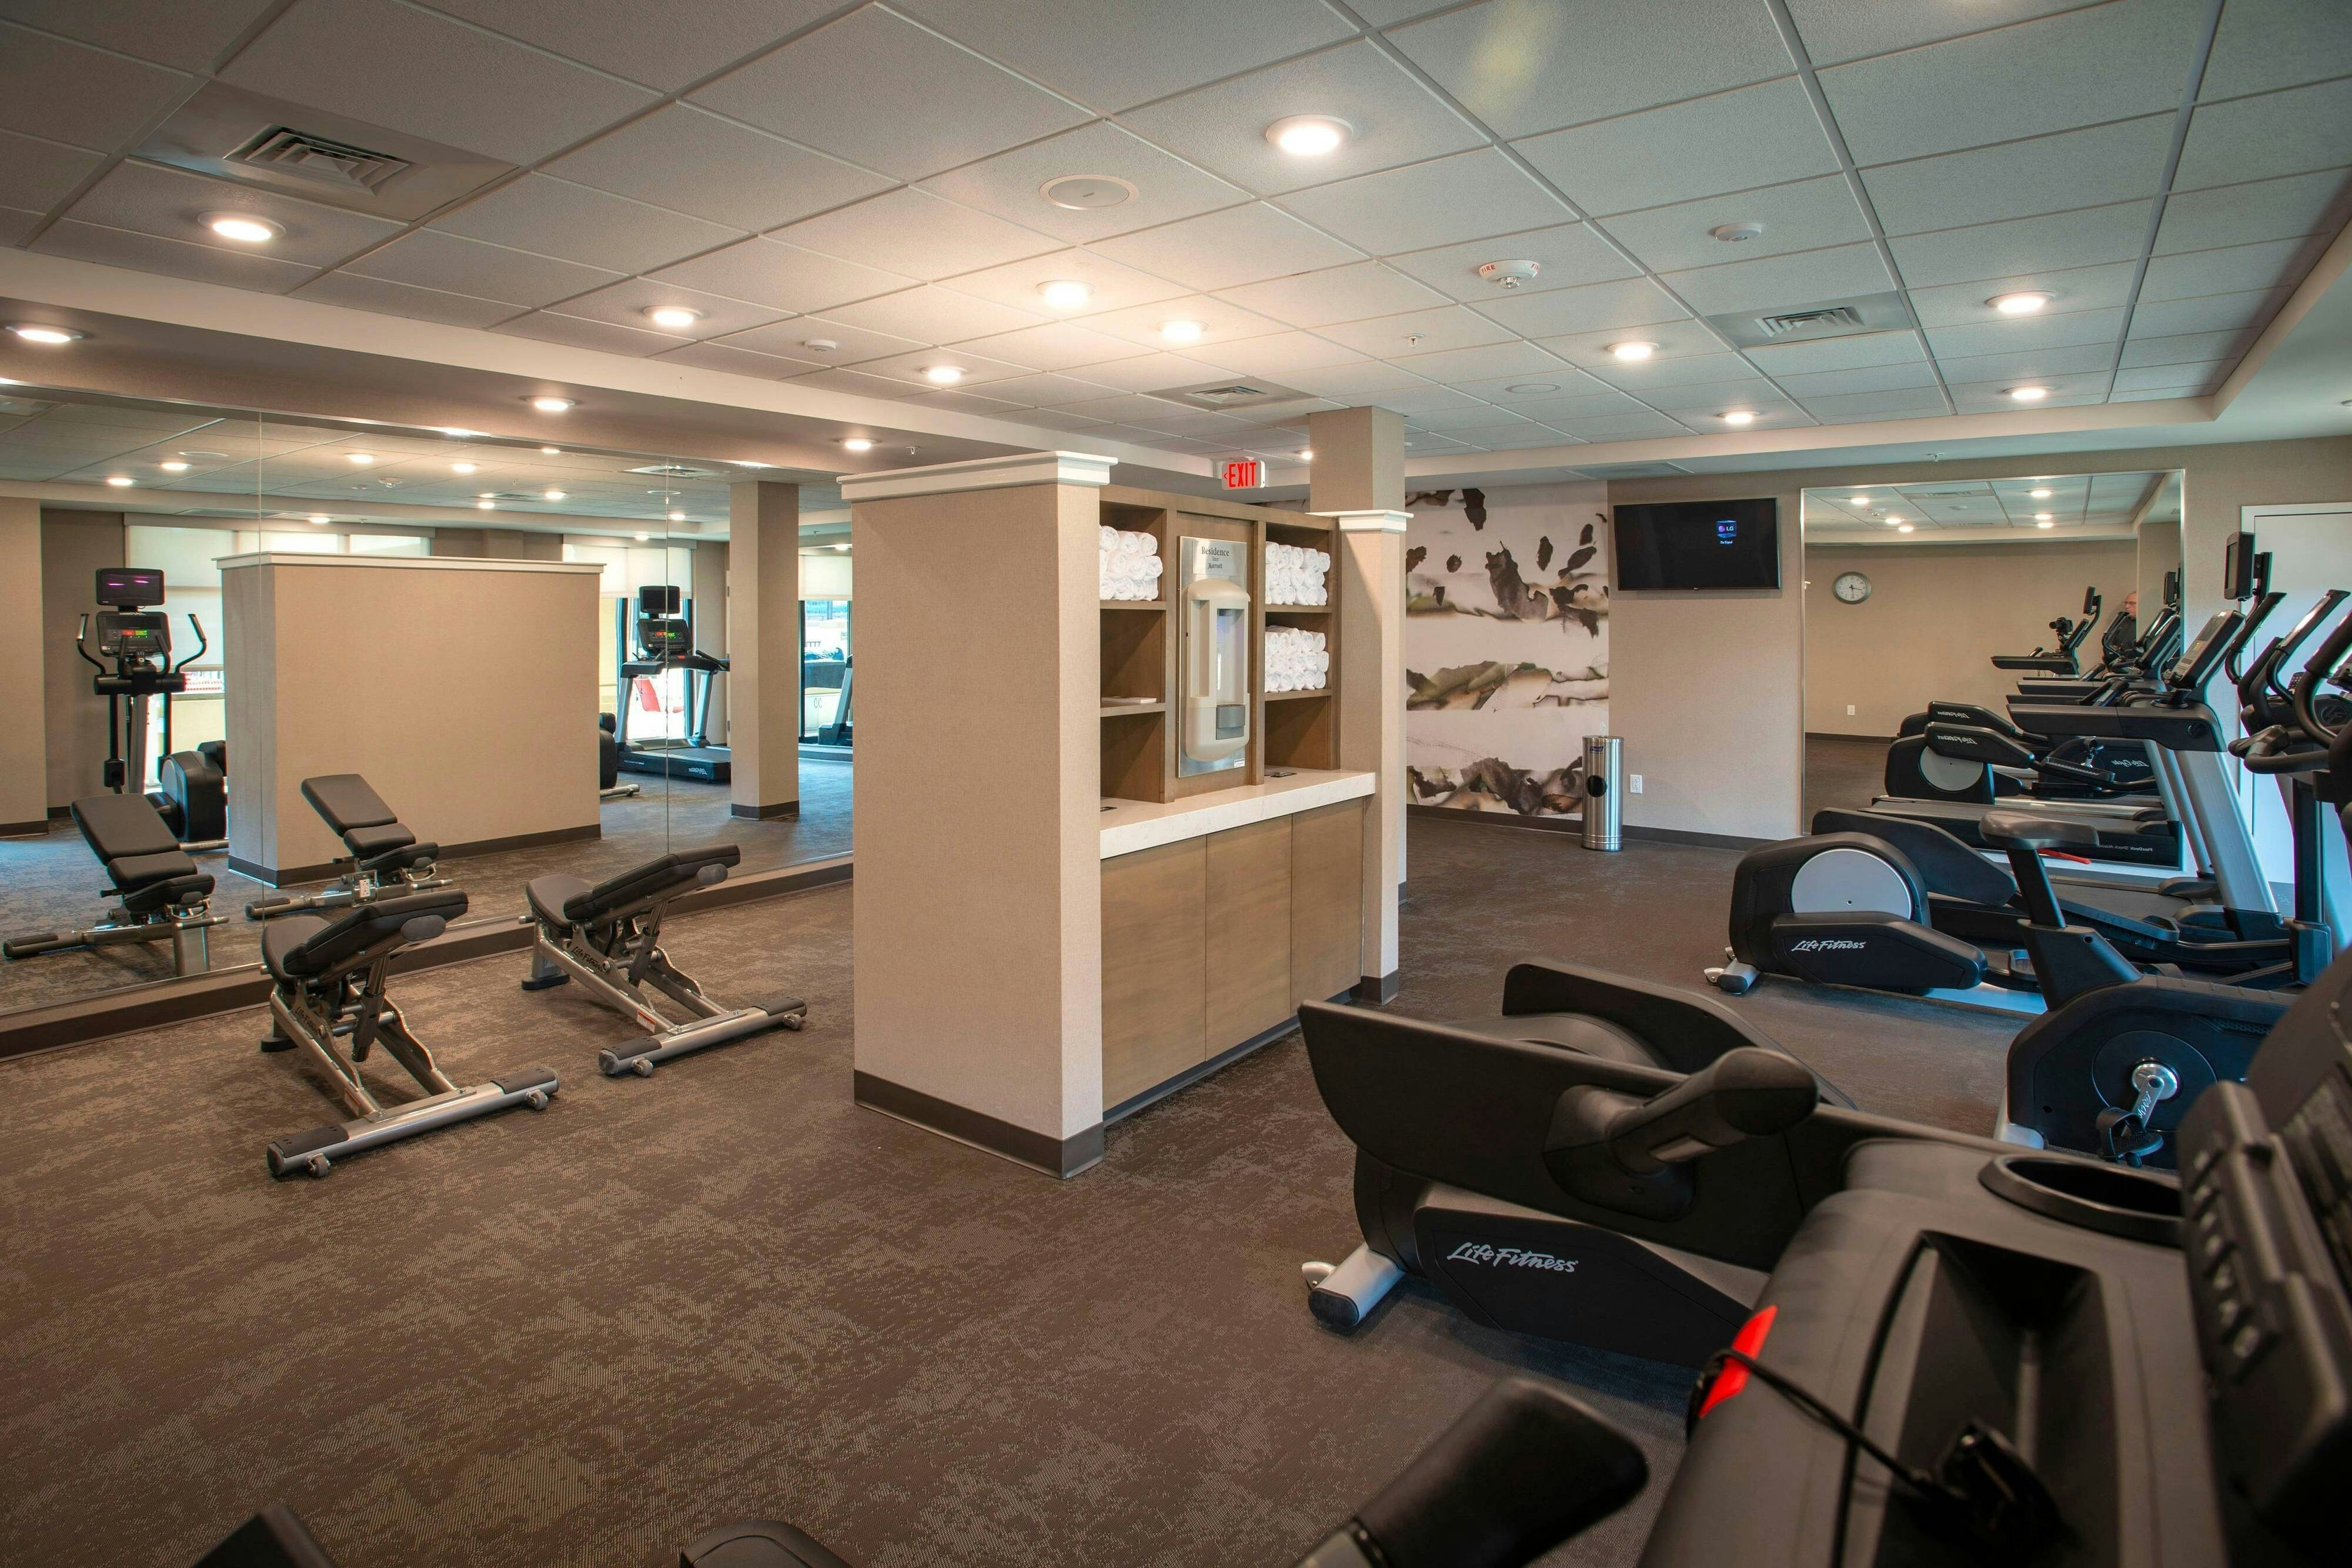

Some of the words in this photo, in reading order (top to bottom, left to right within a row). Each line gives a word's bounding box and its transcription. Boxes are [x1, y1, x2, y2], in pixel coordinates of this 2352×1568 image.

[1481, 264, 1496, 273] FIRE
[1228, 462, 1257, 487] EXIT
[1201, 546, 1230, 556] Residence
[1791, 940, 1819, 952] Life
[1818, 940, 1865, 951] Fitness
[1446, 1242, 1495, 1265] Life
[1492, 1248, 1577, 1273] Fitness
